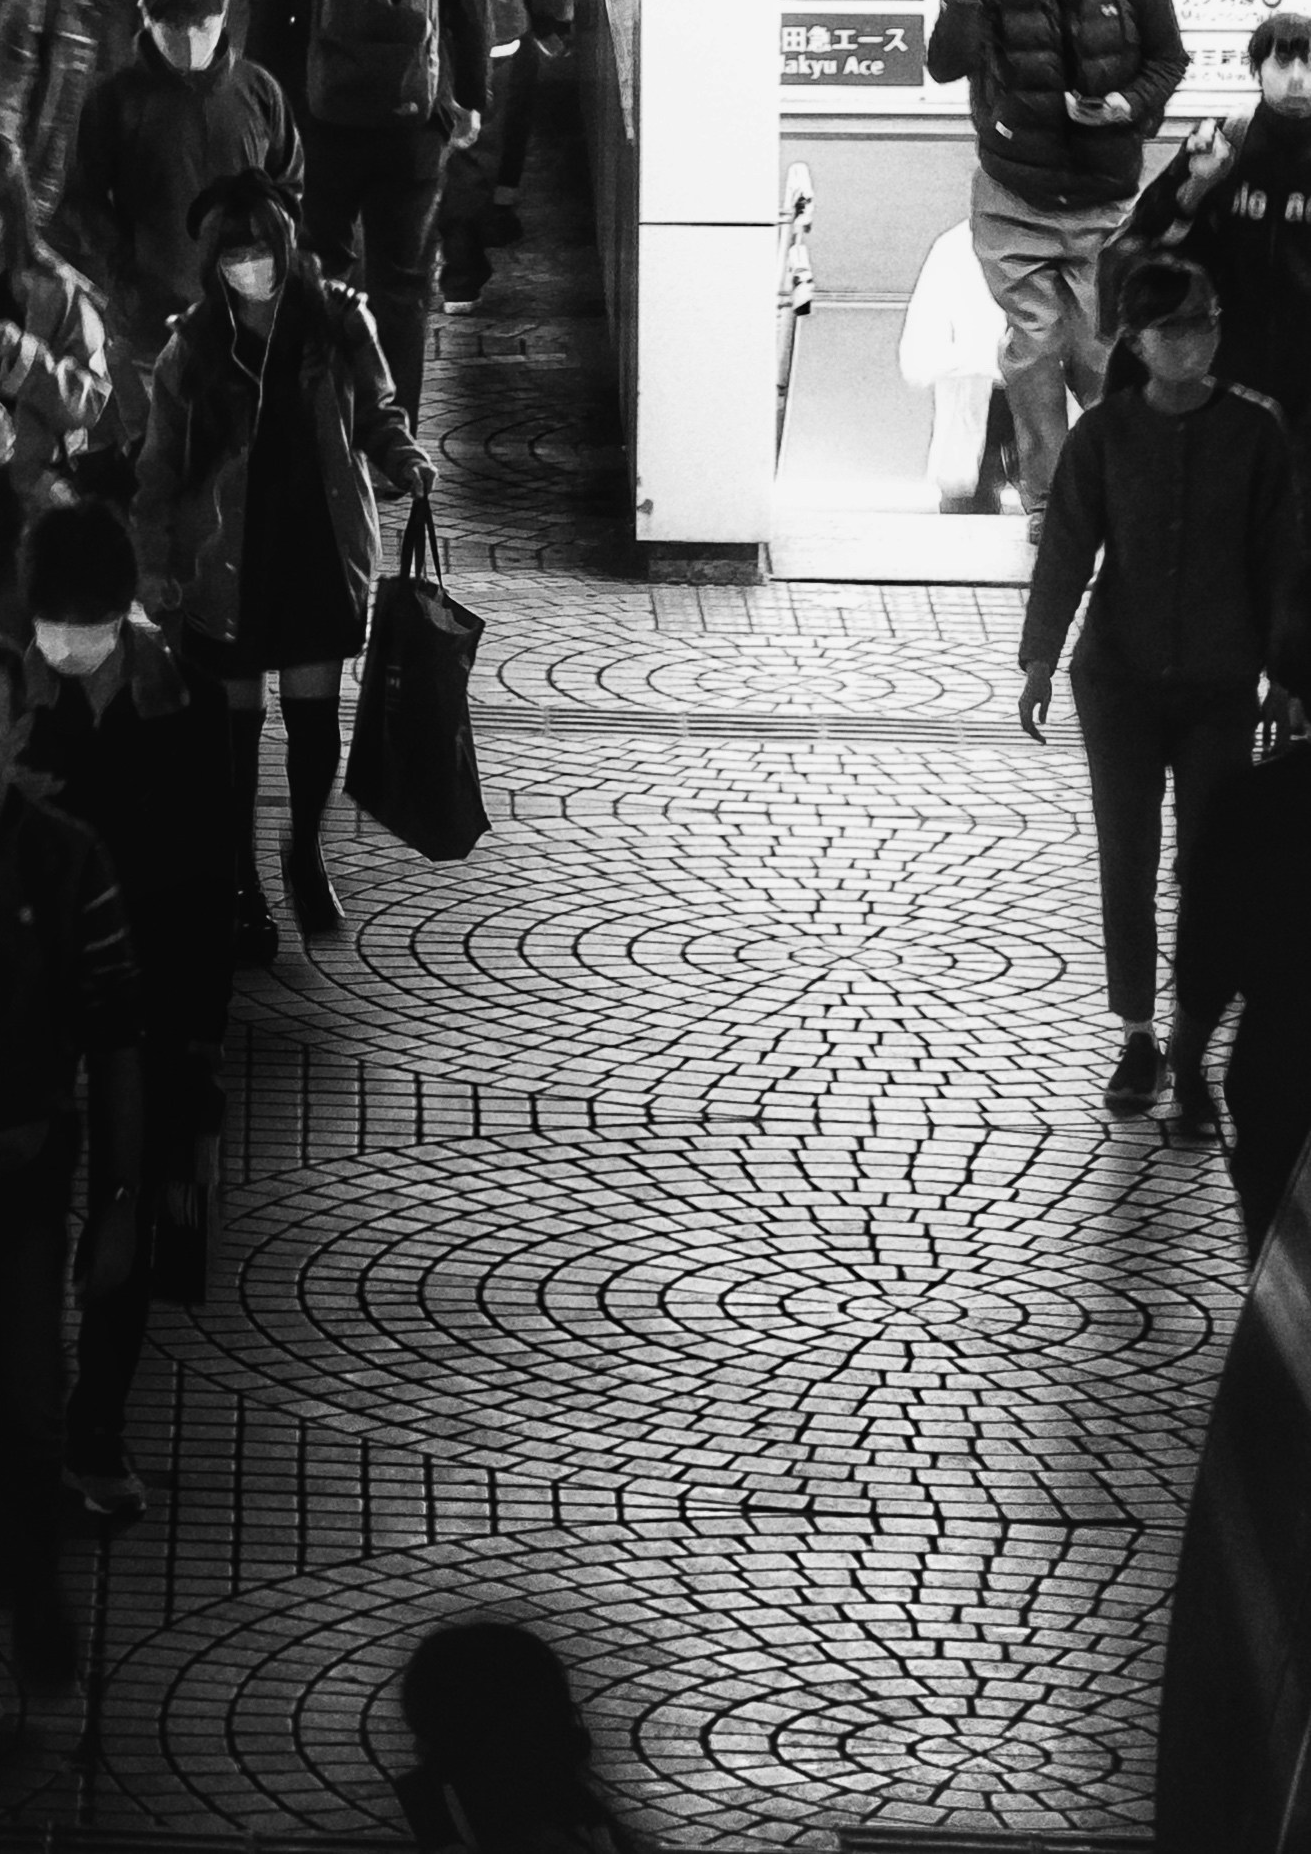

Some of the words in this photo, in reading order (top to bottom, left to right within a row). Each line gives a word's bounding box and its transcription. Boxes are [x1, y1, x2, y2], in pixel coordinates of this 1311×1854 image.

[781, 24, 909, 54] 田急エース
[842, 54, 886, 76] Ace
